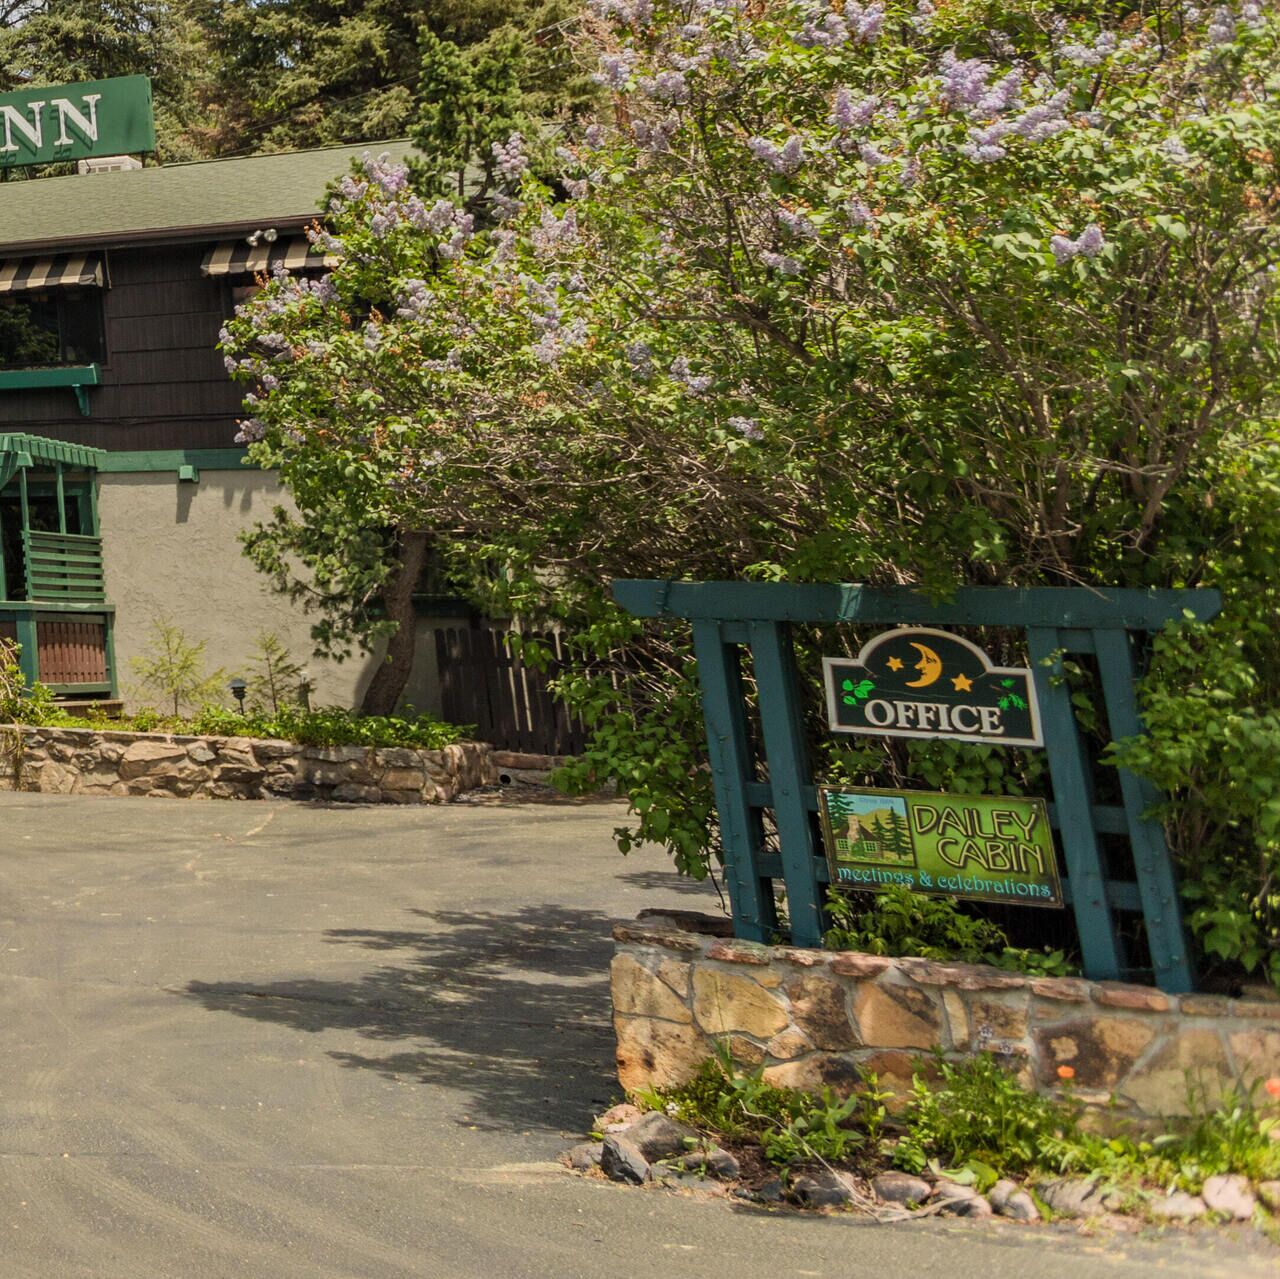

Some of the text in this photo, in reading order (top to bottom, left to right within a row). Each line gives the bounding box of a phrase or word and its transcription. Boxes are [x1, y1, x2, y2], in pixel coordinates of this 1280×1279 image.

[864, 699, 1005, 735] OFFICE
[911, 804, 1038, 841] DAILEY
[935, 836, 1045, 874] CABIN
[837, 867, 1052, 897] meetings & celebrations
